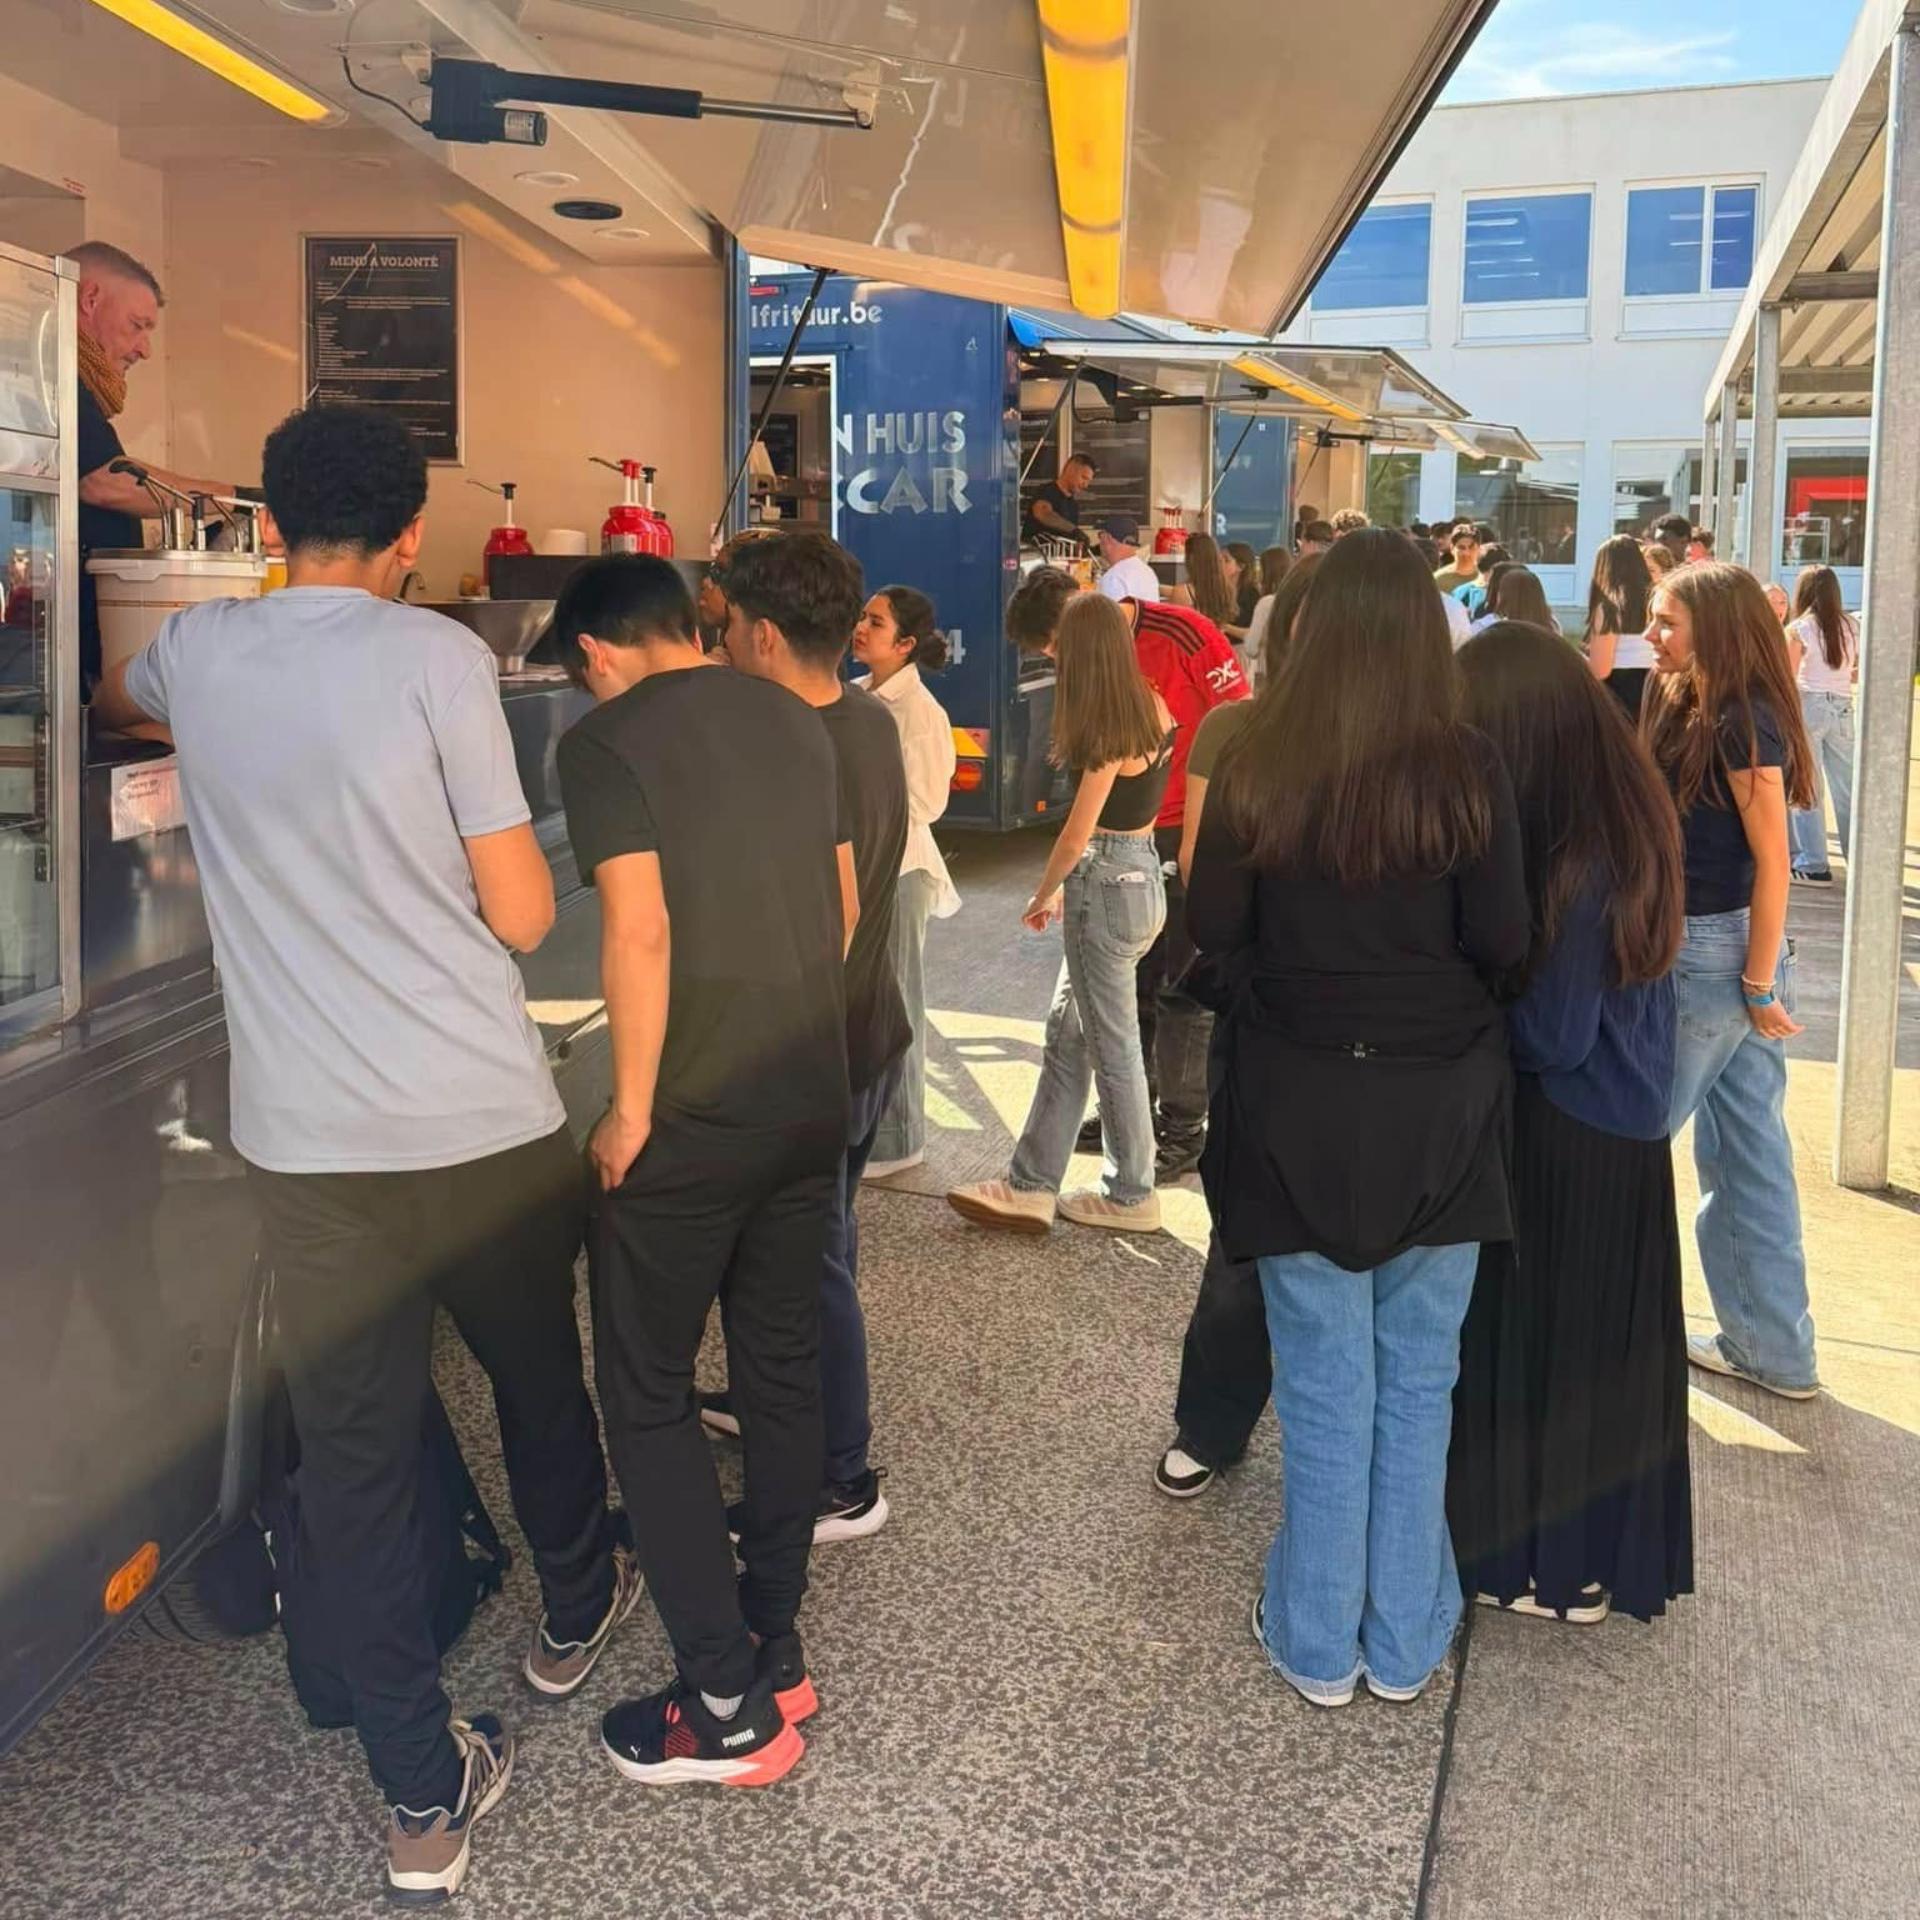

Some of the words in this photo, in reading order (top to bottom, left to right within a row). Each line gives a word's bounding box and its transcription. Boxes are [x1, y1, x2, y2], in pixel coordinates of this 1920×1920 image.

[329, 256, 367, 267] MENU
[867, 411, 966, 454] HUIS
[837, 466, 973, 514] CAR
[722, 1728, 756, 1748] PUMA
